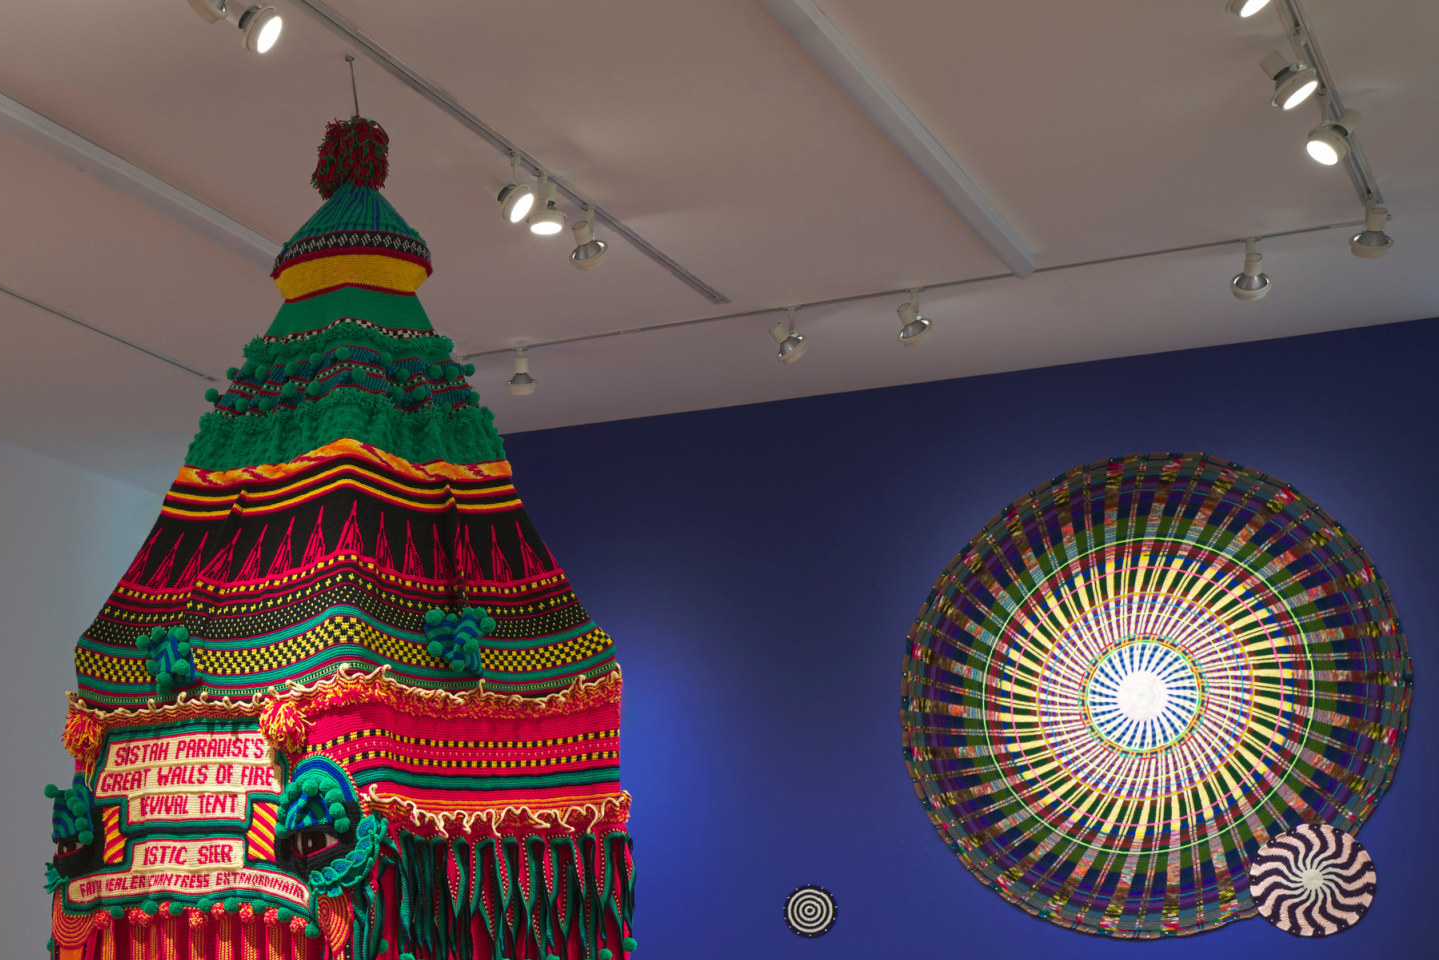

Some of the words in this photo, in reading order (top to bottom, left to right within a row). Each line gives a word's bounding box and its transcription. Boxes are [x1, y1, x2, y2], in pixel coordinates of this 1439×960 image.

[114, 741, 170, 767] SISTAH
[175, 738, 264, 760] PARADISE'S
[100, 768, 151, 793] GREAT
[157, 764, 209, 787] WALLS
[216, 764, 234, 785] OF
[241, 765, 274, 787] FIRE
[198, 793, 238, 814] TENT
[197, 844, 233, 865] SEER
